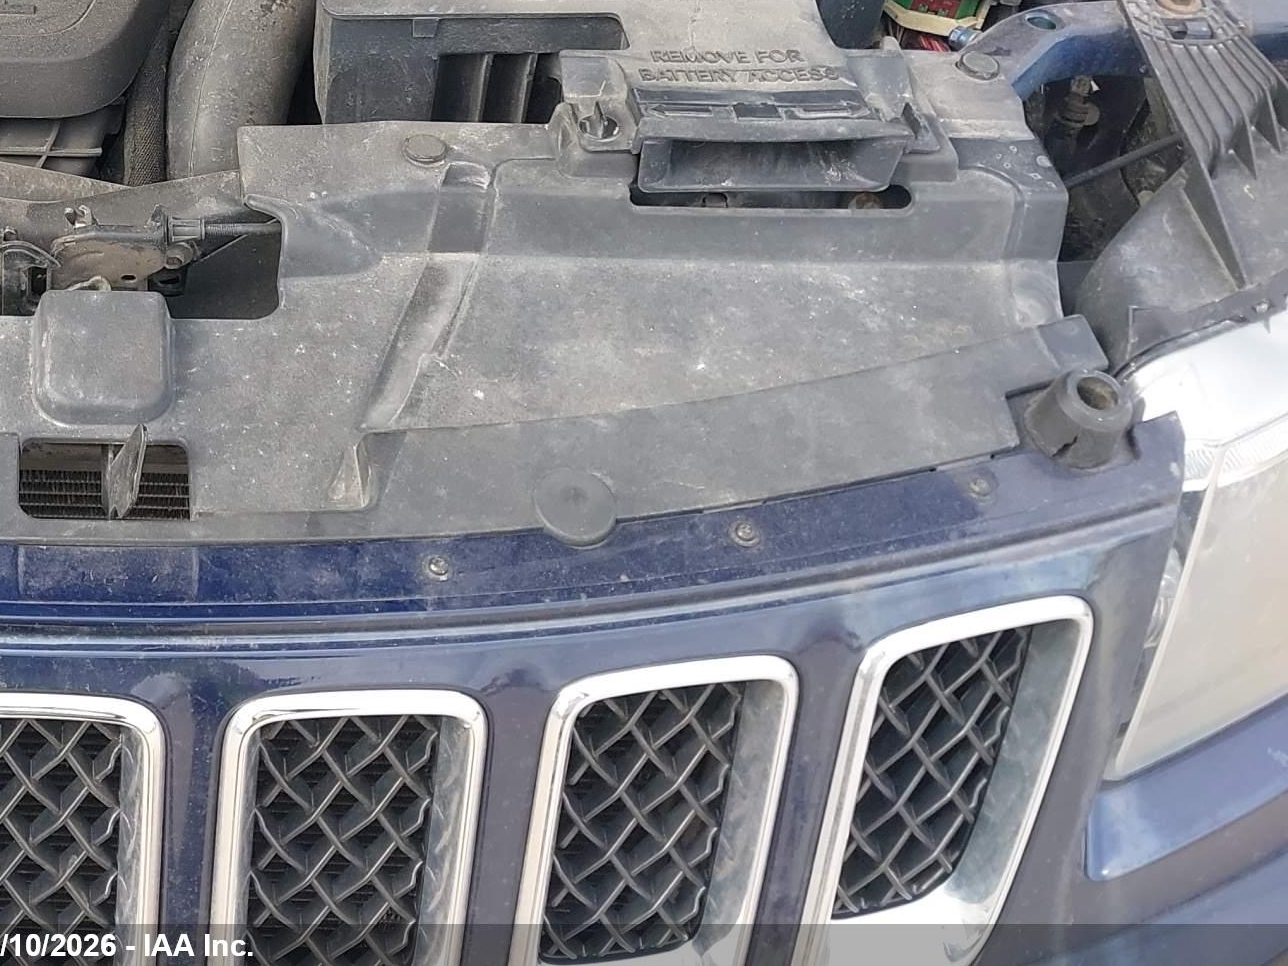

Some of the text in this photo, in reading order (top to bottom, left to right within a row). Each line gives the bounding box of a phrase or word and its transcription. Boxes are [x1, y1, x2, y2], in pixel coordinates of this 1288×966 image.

[649, 48, 805, 64] REMOVE FOR
[638, 67, 842, 83] BATTERY ACCESS
